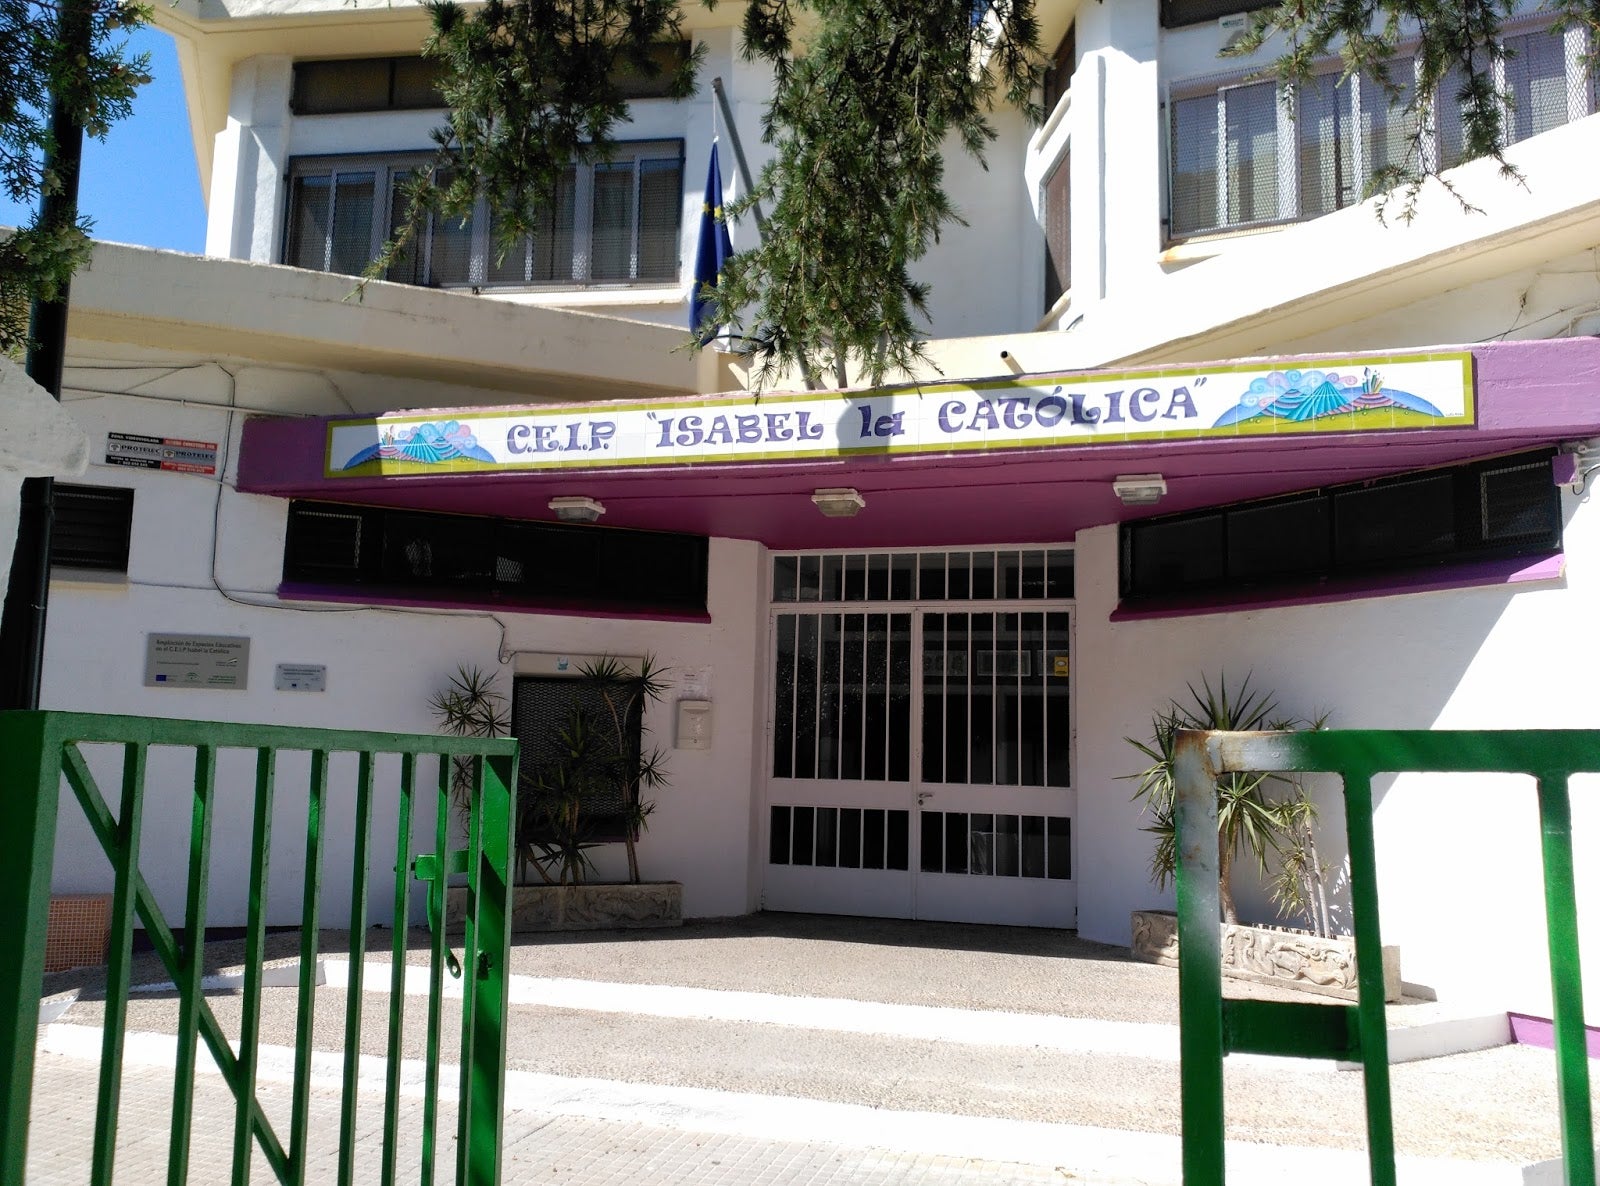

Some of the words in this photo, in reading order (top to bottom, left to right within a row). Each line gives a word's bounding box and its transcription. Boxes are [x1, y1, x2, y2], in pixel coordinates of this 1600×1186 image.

[506, 420, 617, 455] C.E.I.P.
[646, 411, 825, 448] "ISABEL
[858, 404, 905, 439] la
[937, 376, 1208, 433] CATÓLICA"
